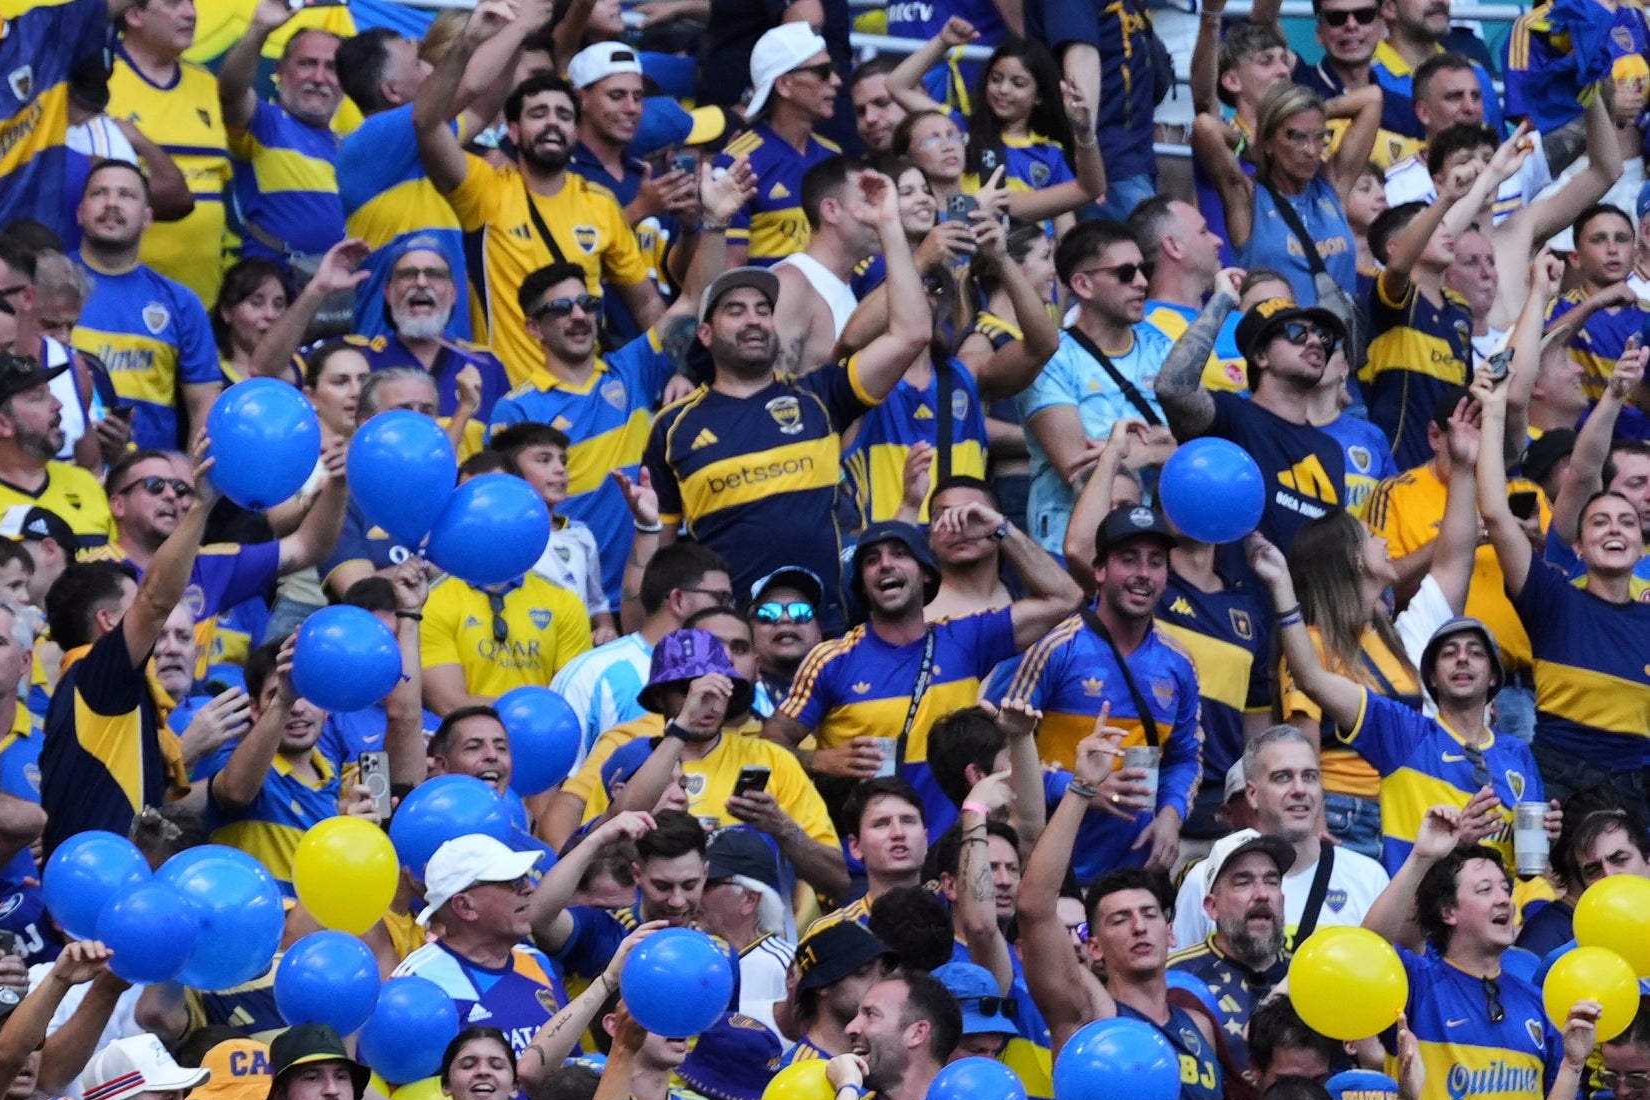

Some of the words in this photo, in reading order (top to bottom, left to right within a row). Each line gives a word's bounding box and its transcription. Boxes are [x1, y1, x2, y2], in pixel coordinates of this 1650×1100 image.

[707, 453, 815, 495] betsson
[476, 637, 541, 663] QATAR
[229, 1050, 273, 1076] CA
[1179, 1055, 1216, 1090] BJ
